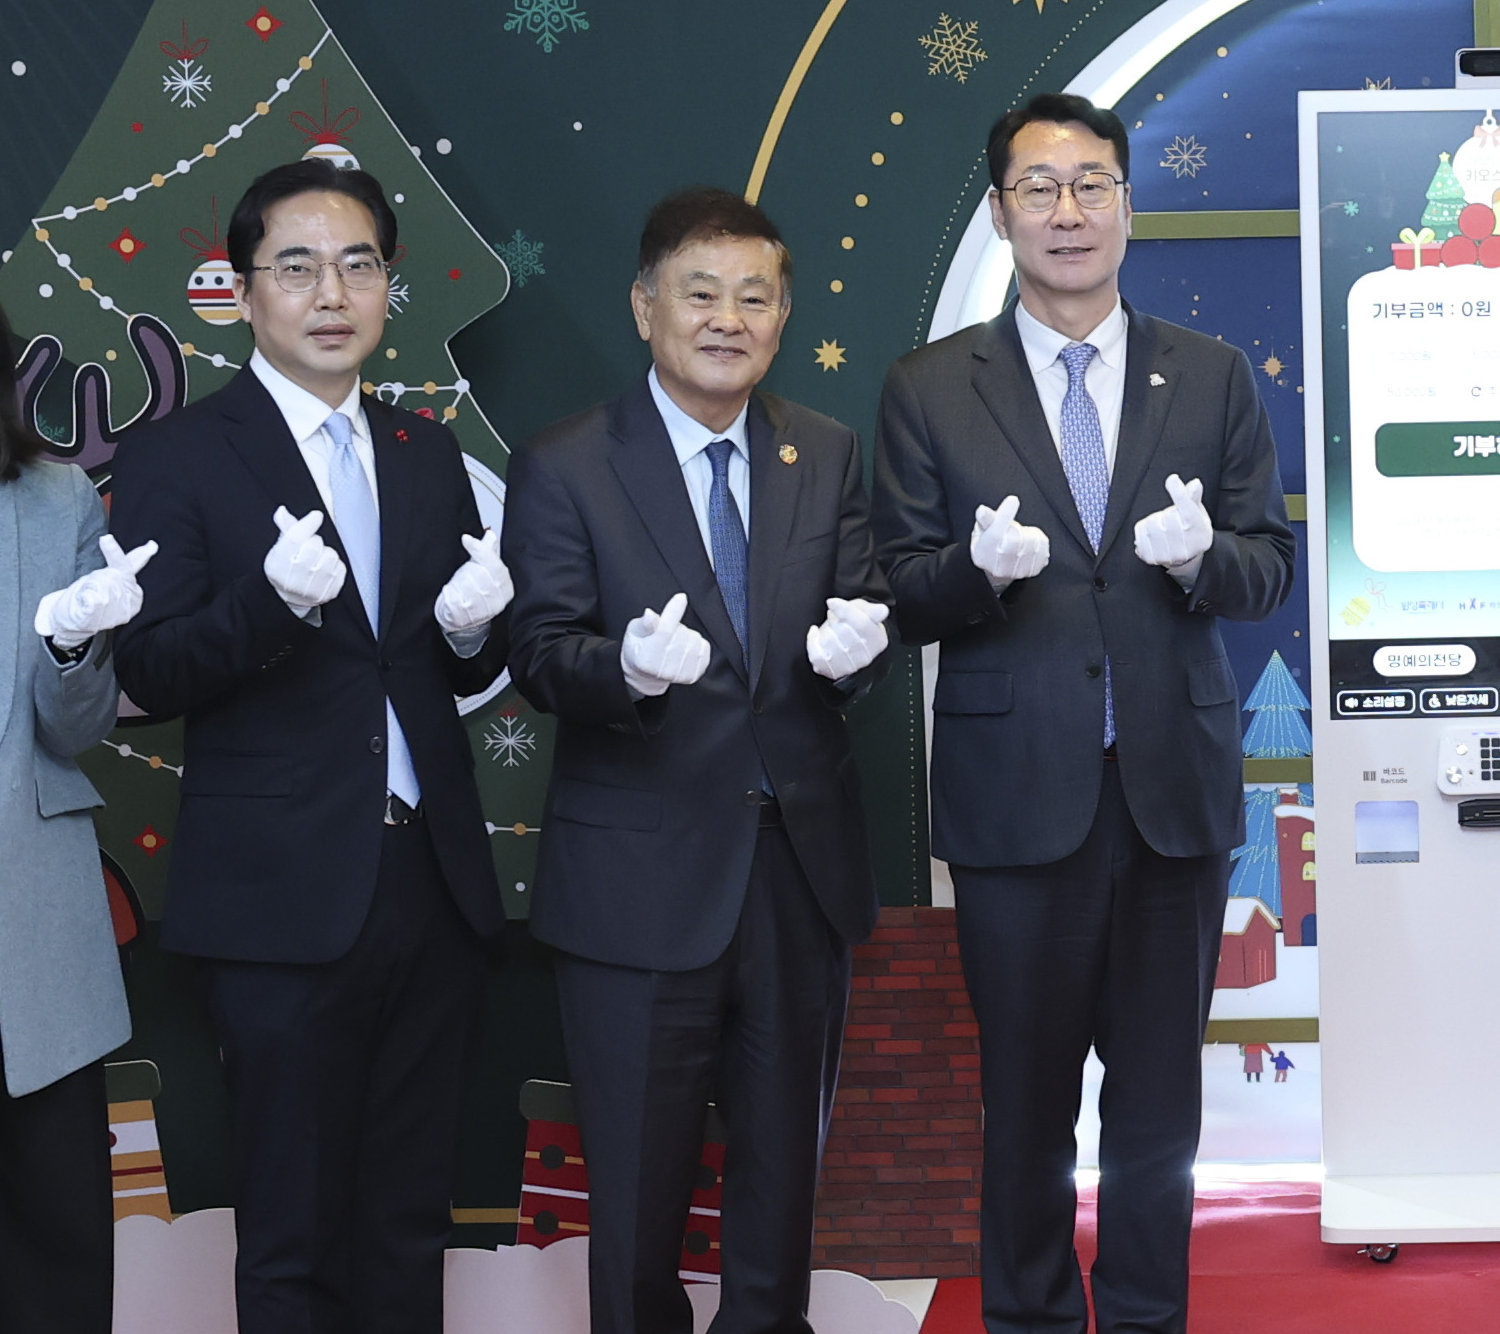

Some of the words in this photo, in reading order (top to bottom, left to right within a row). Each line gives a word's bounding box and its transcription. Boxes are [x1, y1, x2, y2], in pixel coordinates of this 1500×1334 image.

[1372, 302, 1444, 318] 기부금액
[1461, 301, 1492, 317] 0원
[1388, 653, 1462, 668] 명예의전당
[1362, 696, 1406, 708] 소리설정
[1445, 694, 1489, 706] 낮은자세
[1383, 768, 1405, 777] 바코드
